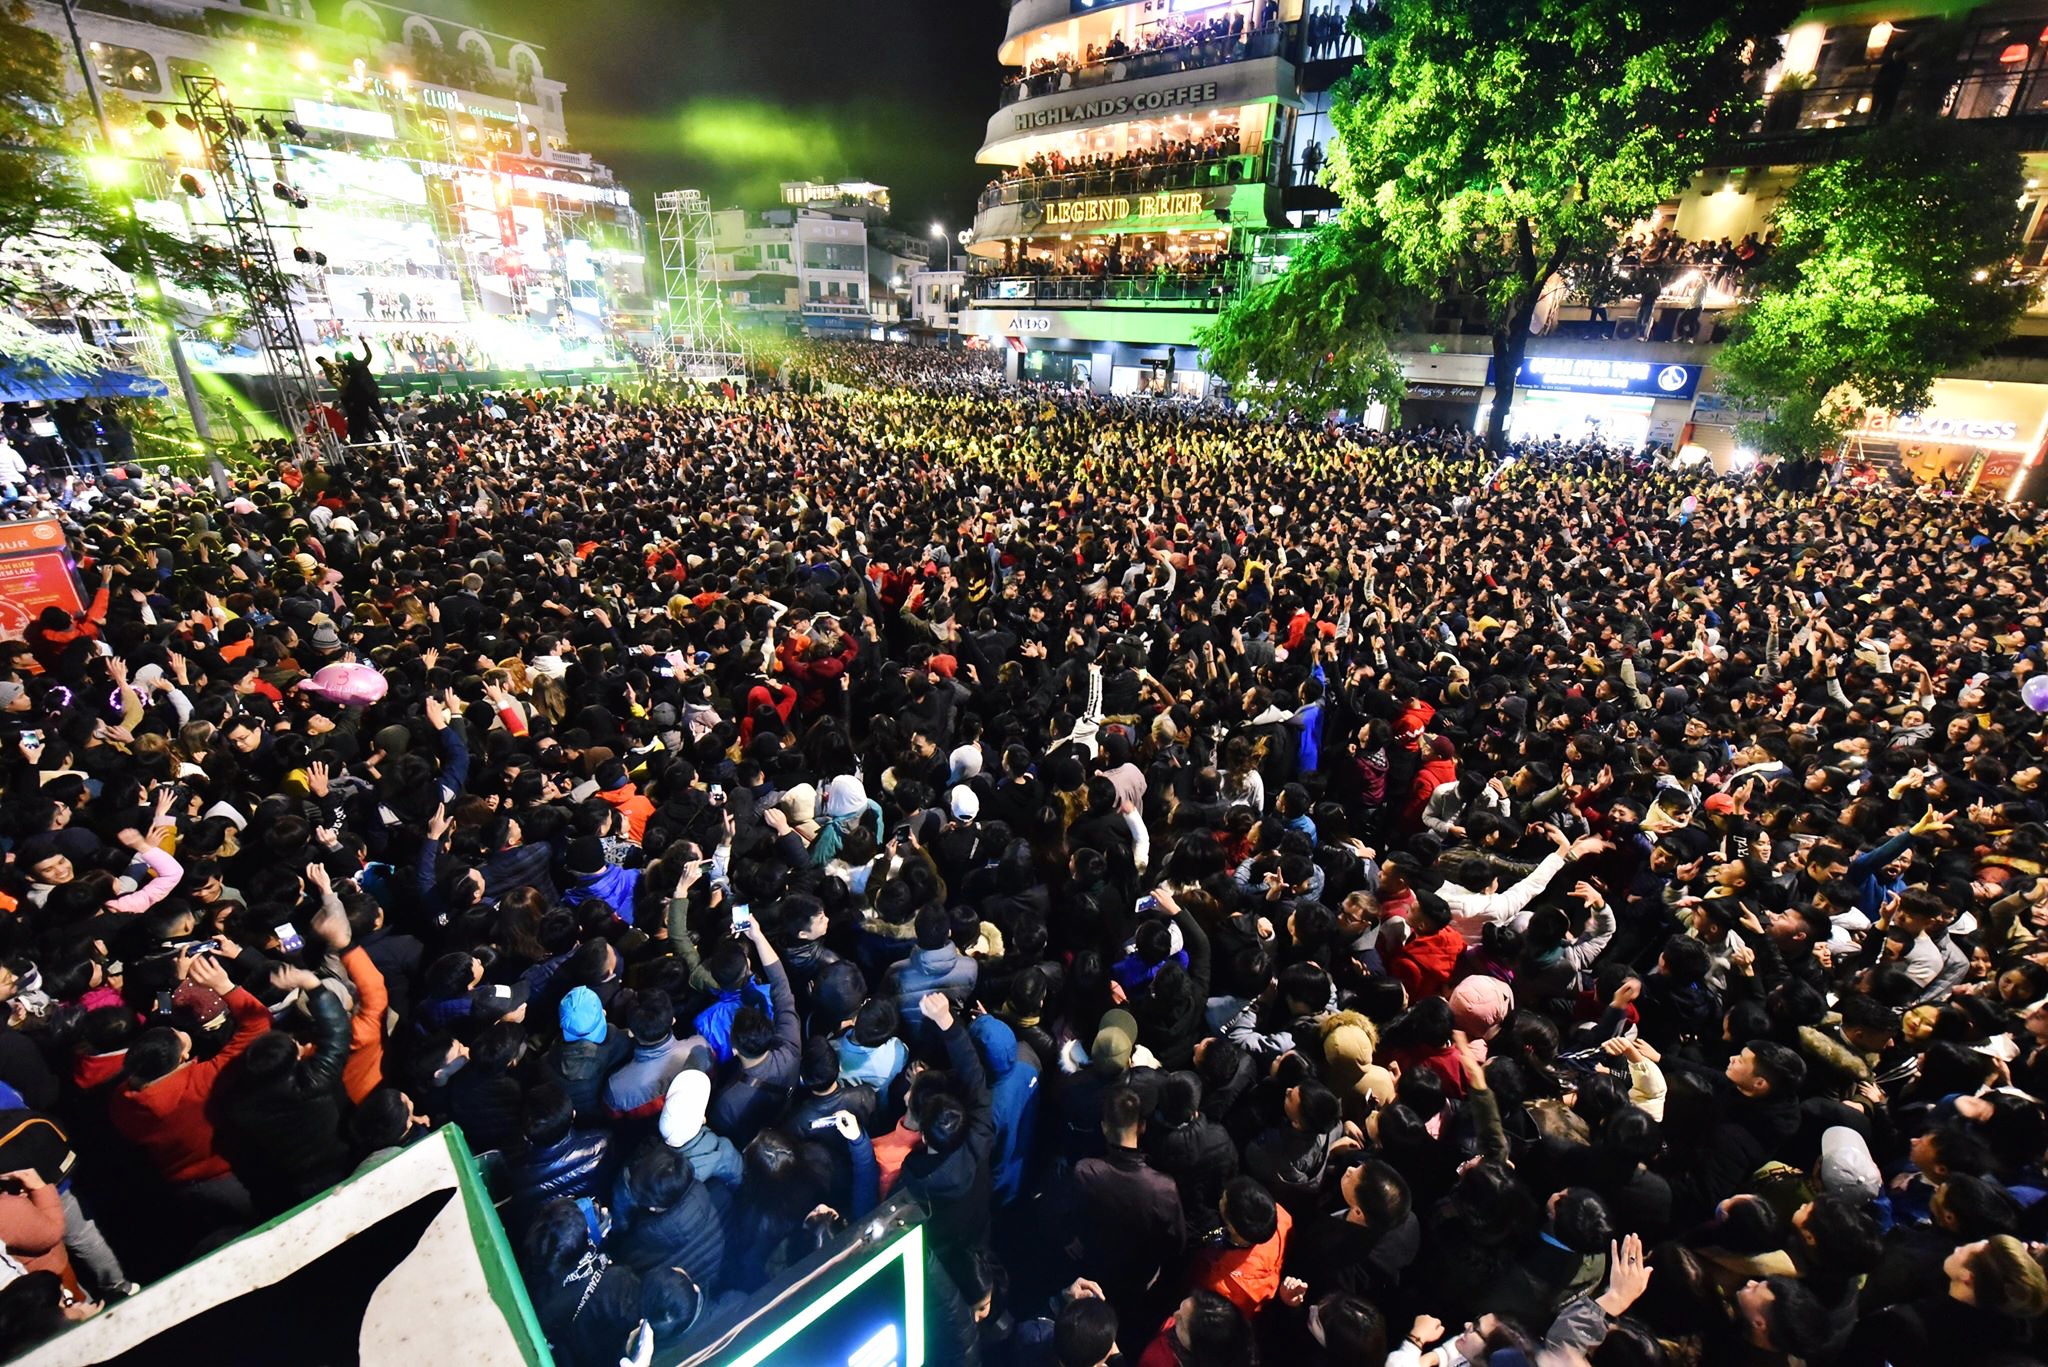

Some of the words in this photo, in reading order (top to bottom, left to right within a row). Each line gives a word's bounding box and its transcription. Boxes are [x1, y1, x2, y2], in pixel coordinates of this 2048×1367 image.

[1015, 97, 1132, 130] HIGHLANDS
[1133, 82, 1217, 111] COFFEE
[1046, 198, 1130, 224] LEGEND
[1139, 192, 1203, 218] BEER
[1008, 316, 1050, 331] ALDO
